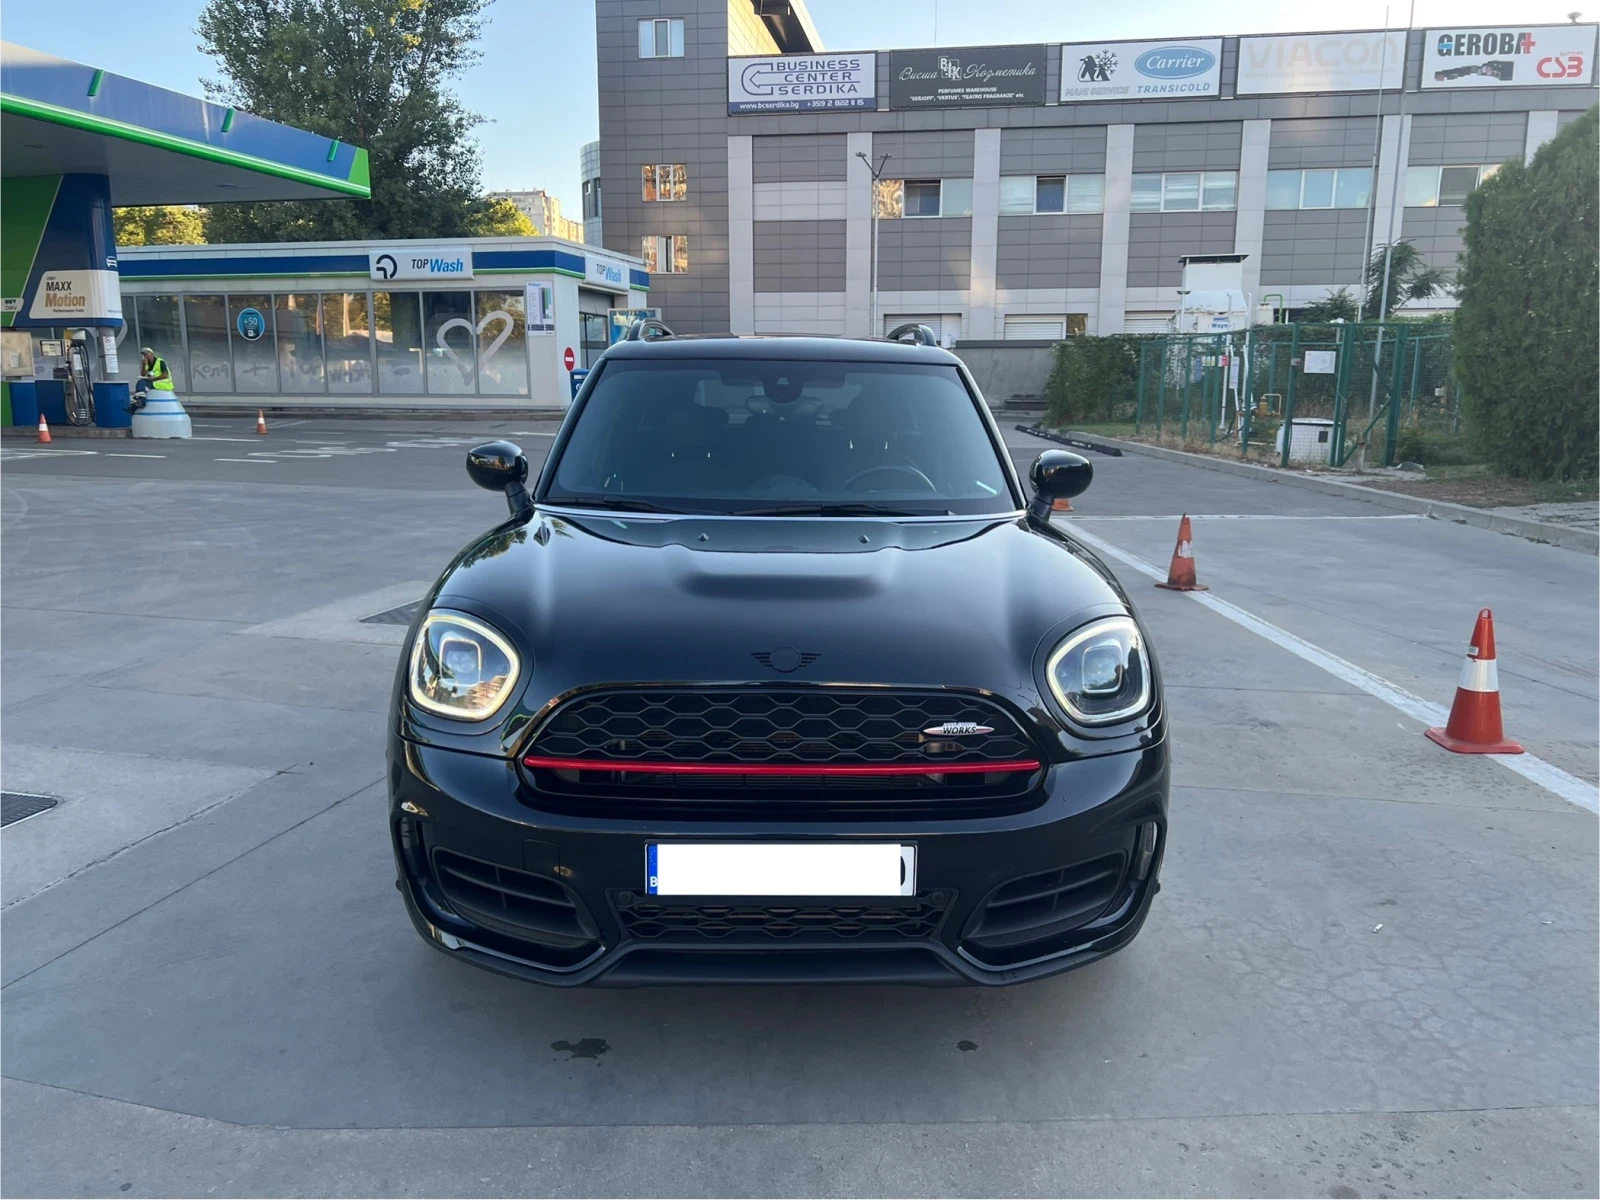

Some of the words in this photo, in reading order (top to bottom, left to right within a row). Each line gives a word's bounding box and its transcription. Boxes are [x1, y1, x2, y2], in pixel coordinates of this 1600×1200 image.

[776, 59, 860, 71] BUSINESS
[1146, 55, 1205, 69] Carrier
[1536, 56, 1584, 78] CSB
[784, 72, 852, 83] CENTER
[899, 66, 938, 81] Висша
[963, 62, 1036, 82] Козметика
[778, 84, 858, 96] SERDIKA
[1137, 83, 1210, 94] TRANSICOLD
[740, 101, 799, 110] www.bcserdika.bg
[411, 258, 428, 270] TOP
[429, 257, 464, 273] Wash
[596, 263, 606, 275] TOP
[604, 265, 622, 283] Wash
[46, 281, 72, 292] MAXX
[45, 292, 86, 307] Motion
[943, 726, 976, 734] WORKS
